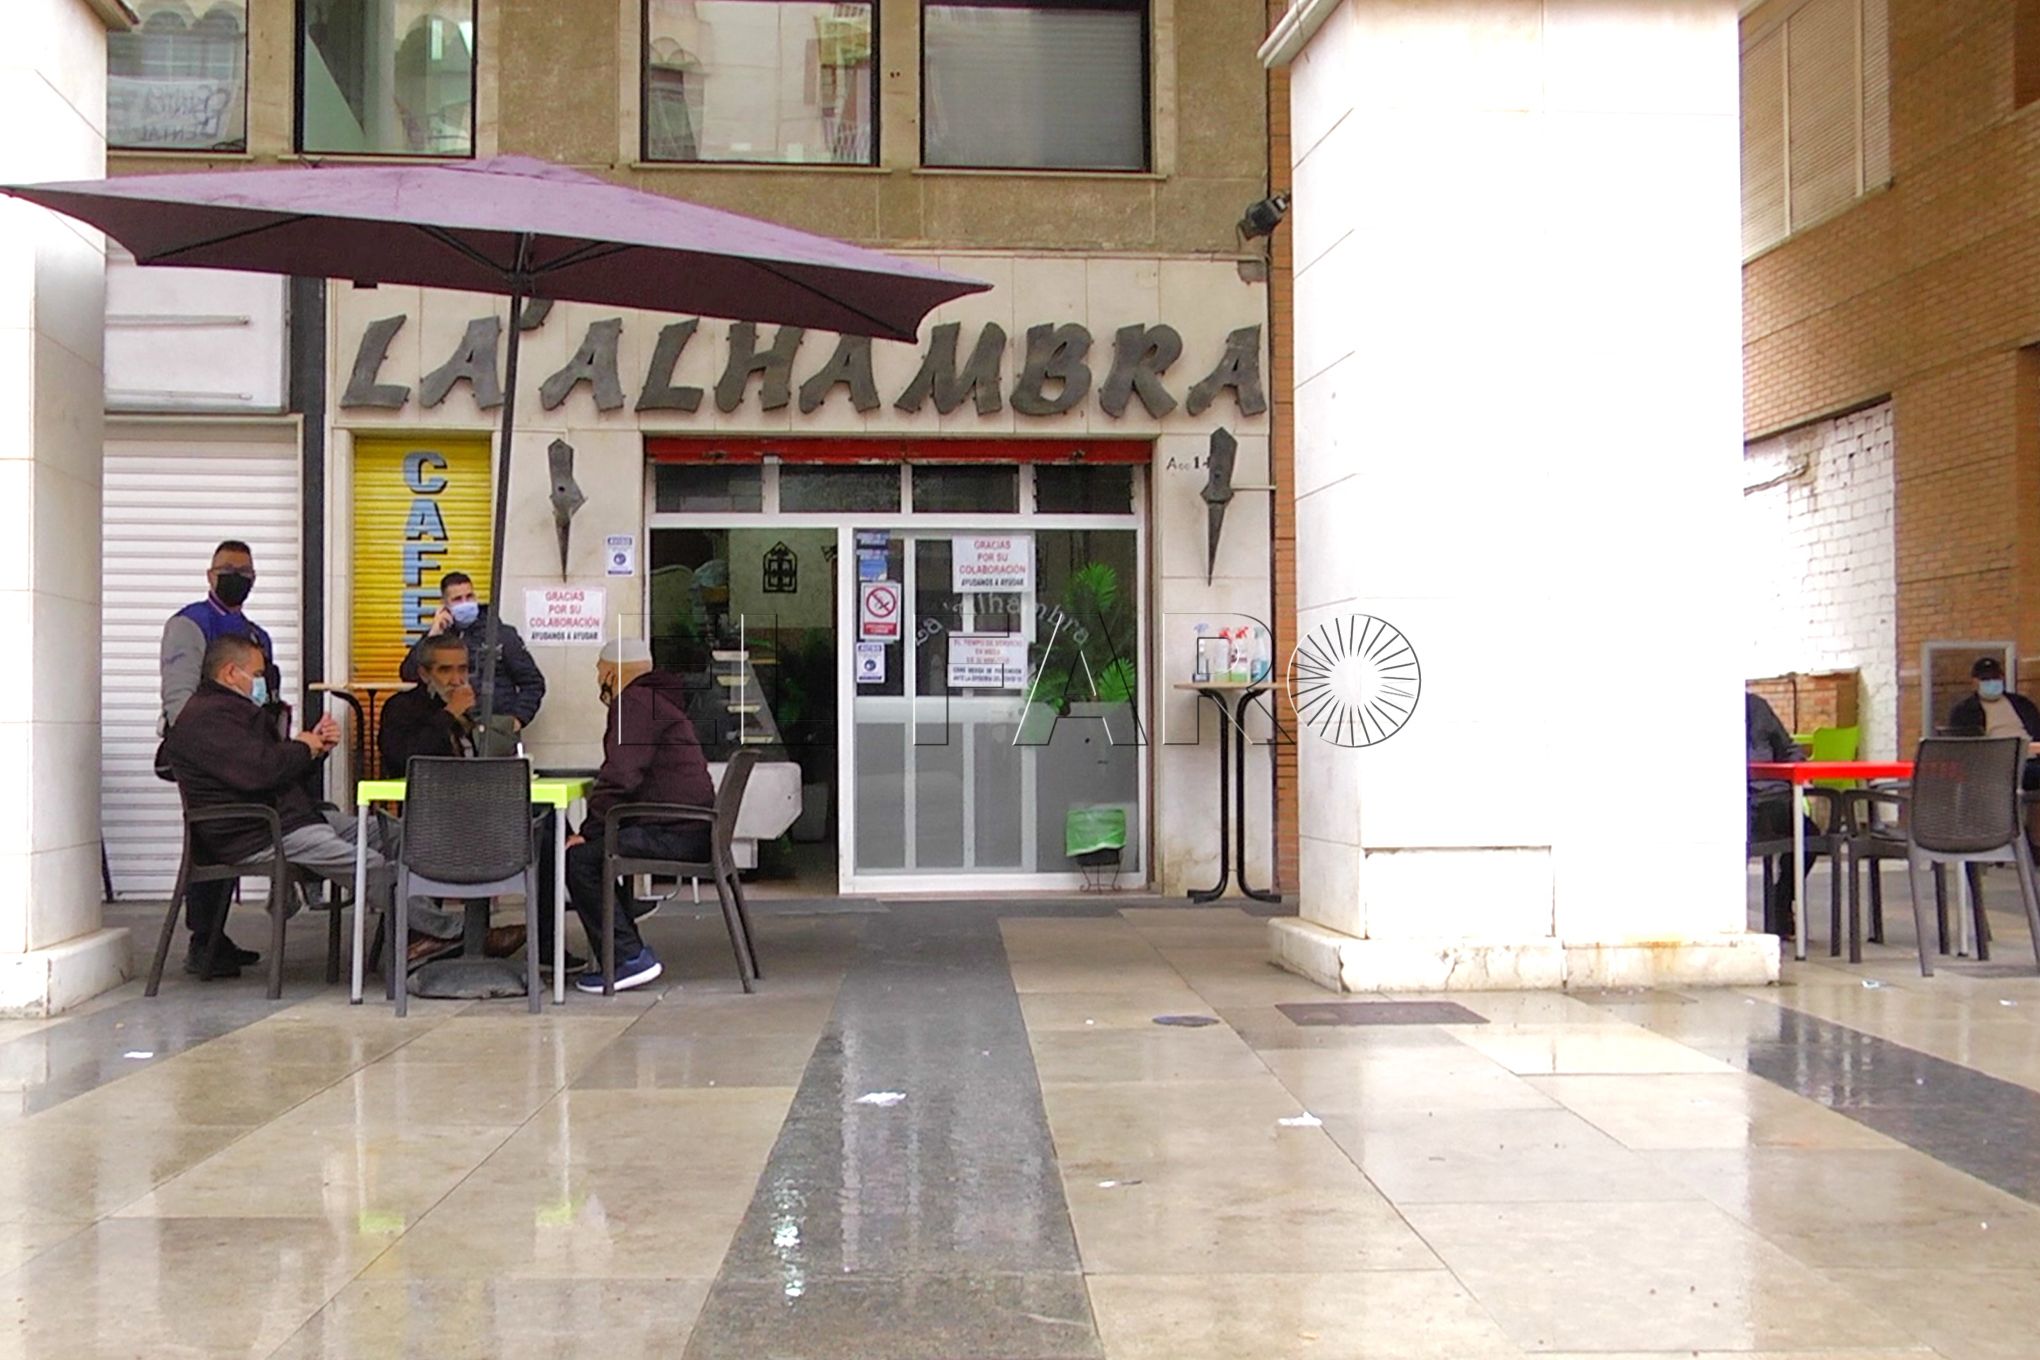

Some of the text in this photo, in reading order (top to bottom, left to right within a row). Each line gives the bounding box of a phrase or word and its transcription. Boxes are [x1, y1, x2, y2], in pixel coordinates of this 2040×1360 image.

[340, 314, 504, 410] LA
[974, 540, 1011, 549] GRACIAS
[977, 553, 1008, 562] POR SU
[545, 591, 584, 602] GRACIAS
[548, 604, 581, 614] POR SU
